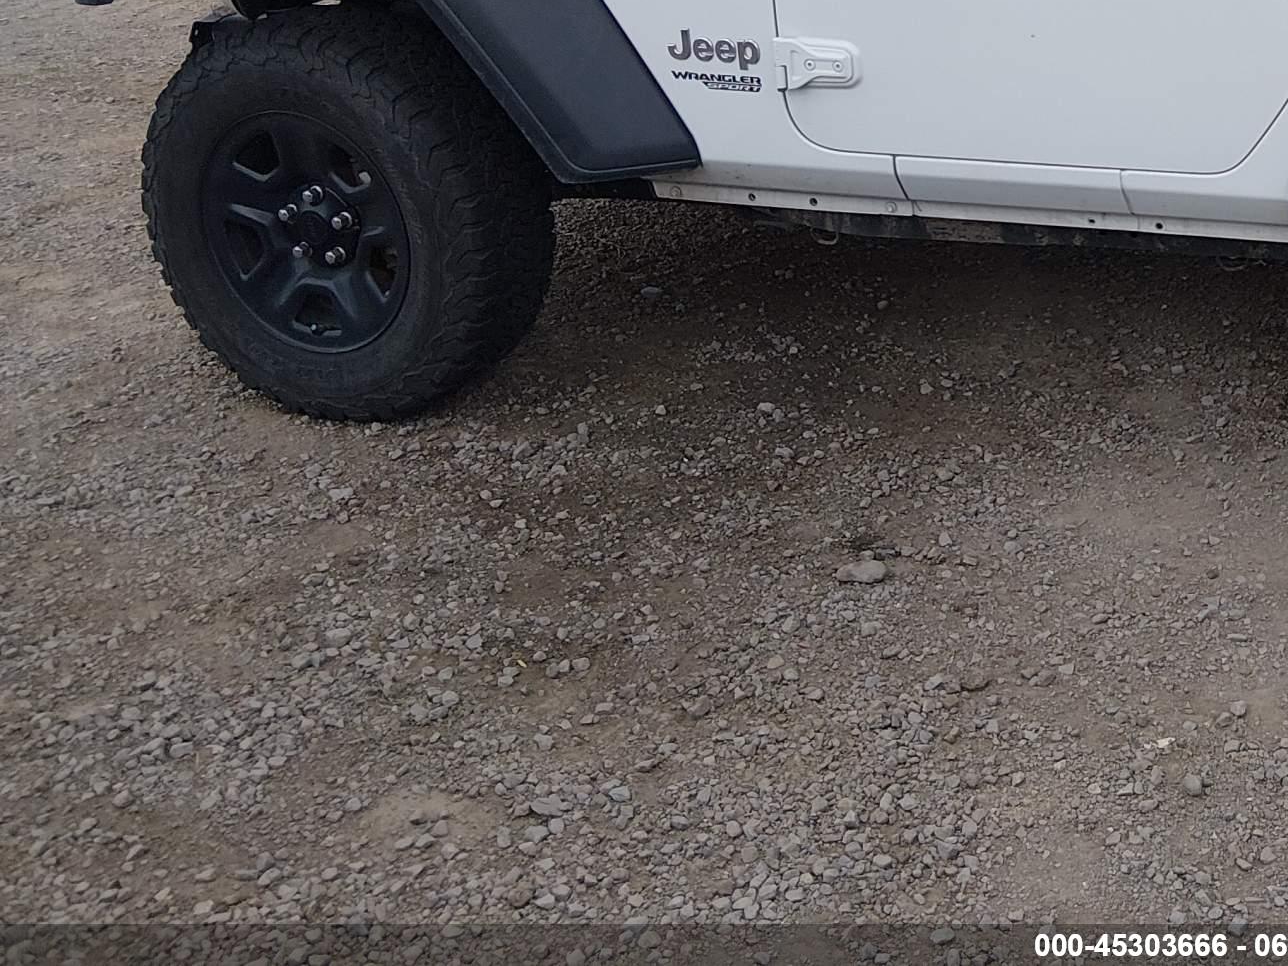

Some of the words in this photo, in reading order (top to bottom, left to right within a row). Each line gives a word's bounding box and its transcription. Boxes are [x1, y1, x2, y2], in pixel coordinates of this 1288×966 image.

[667, 28, 760, 70] Jeep
[671, 70, 761, 84] WRANGLER
[706, 82, 762, 92] SPORT
